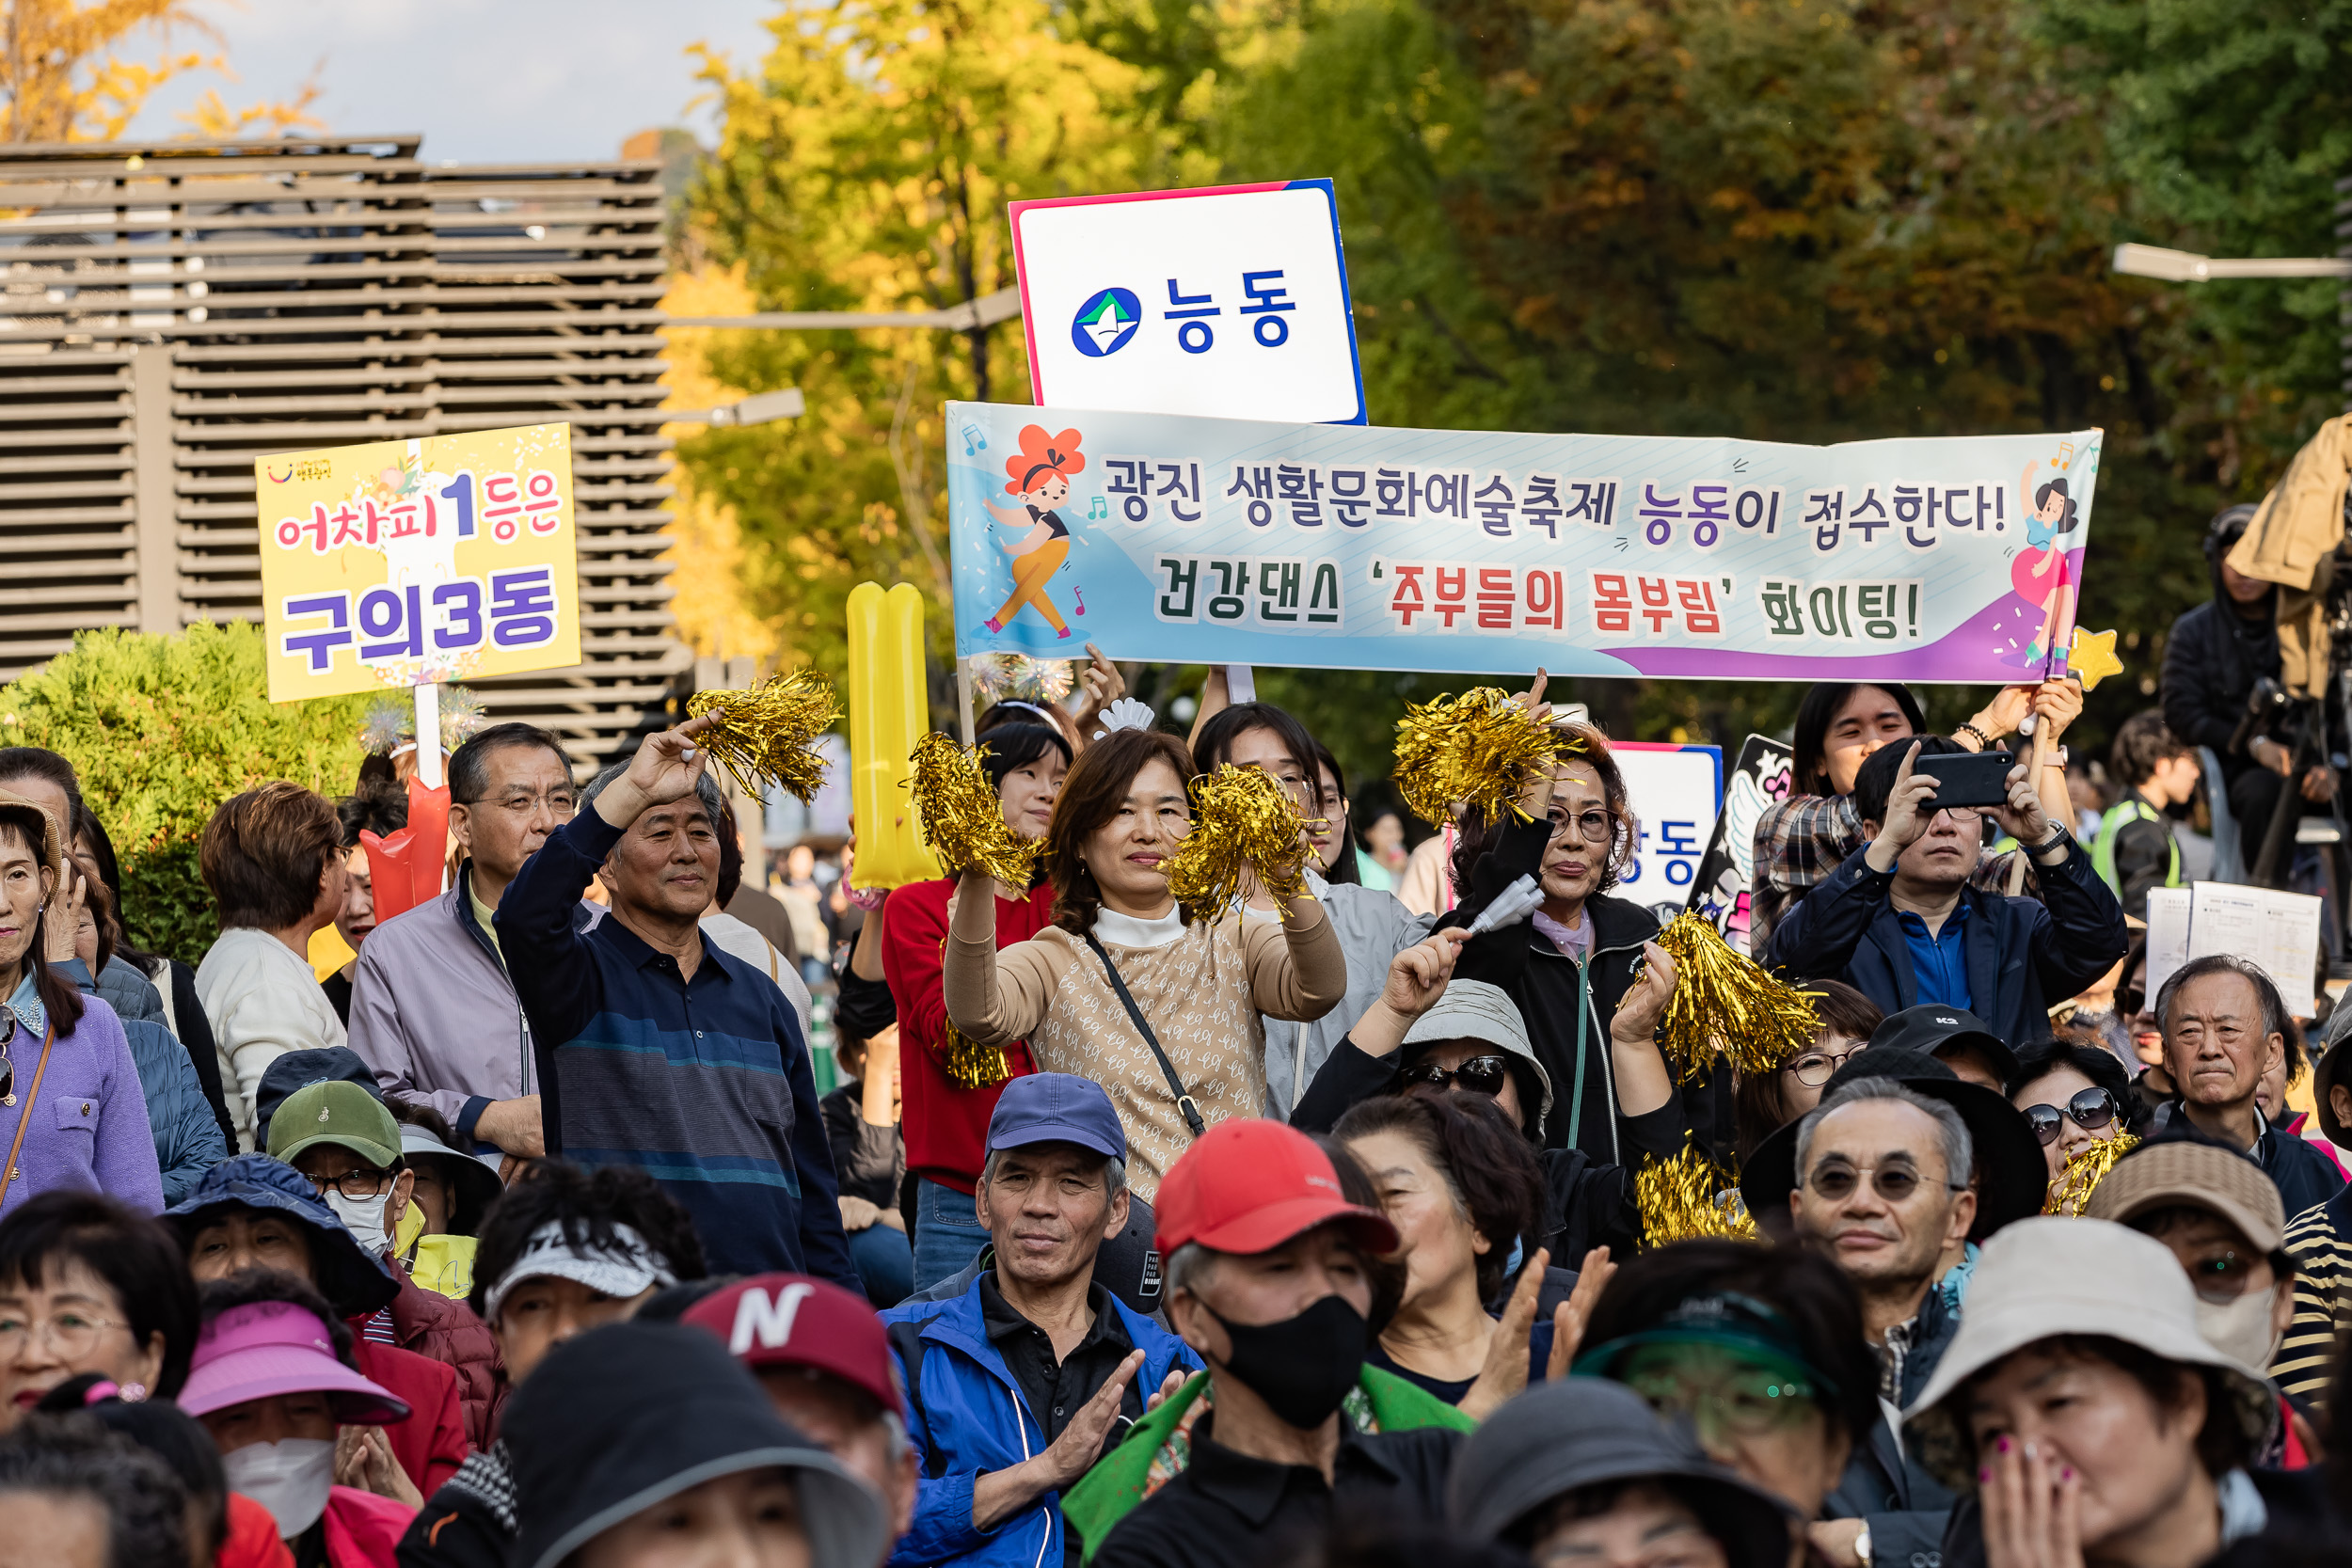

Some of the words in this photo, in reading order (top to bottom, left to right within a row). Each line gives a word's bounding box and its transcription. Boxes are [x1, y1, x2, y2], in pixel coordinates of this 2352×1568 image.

[1164, 270, 1295, 354] 능동
[1105, 460, 1202, 521] 광진
[1227, 463, 1618, 539] 생활문화예술축제
[1639, 484, 1780, 547] 능동이
[1804, 484, 2005, 551] 접수한다!
[286, 569, 554, 670] 구의3동
[1159, 559, 1339, 623] 건강댄스
[1761, 581, 1918, 640] 화이팅!
[1935, 1017, 1959, 1025] K2
[729, 1282, 816, 1355] N
